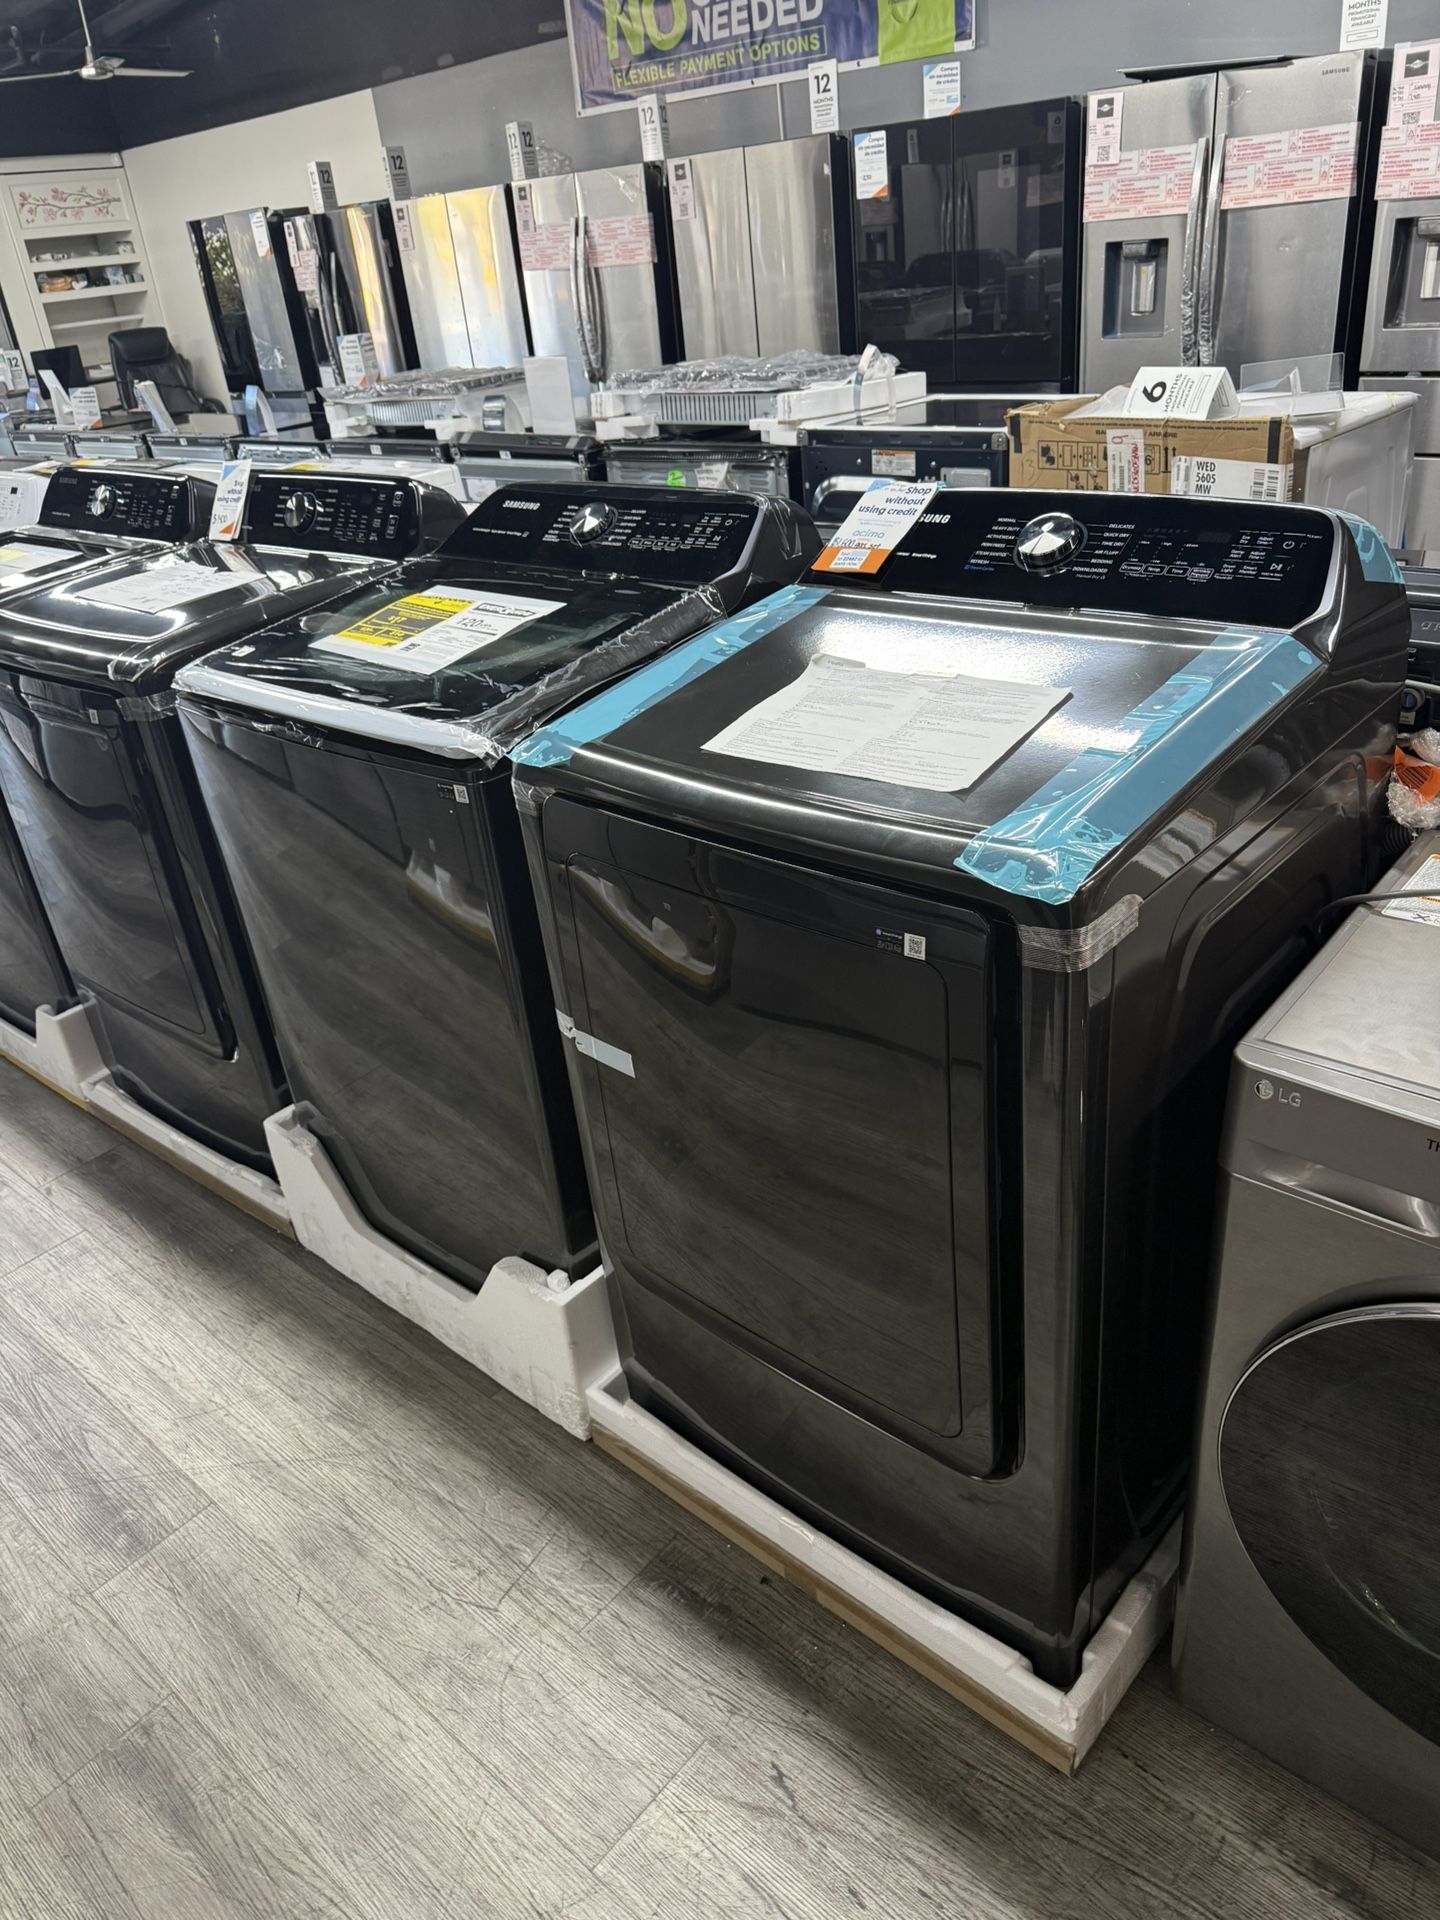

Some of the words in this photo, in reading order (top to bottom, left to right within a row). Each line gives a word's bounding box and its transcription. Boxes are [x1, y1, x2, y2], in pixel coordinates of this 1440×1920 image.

[1348, 0, 1382, 11] MONTHS
[604, 0, 688, 60] NO
[691, 0, 824, 46] NEEDED
[615, 62, 675, 89] FLEXIBLE
[679, 47, 746, 75] PAYMENT
[749, 32, 821, 62] OPTIONS
[814, 73, 831, 94] 12
[641, 105, 655, 125] 12
[521, 131, 533, 148] 12
[391, 154, 404, 171] 12
[320, 169, 332, 184] 12
[7, 356, 20, 369] 12
[1142, 381, 1167, 403] 6
[1164, 373, 1183, 413] MONTHS
[1196, 461, 1216, 472] WED
[1195, 472, 1216, 484] 5605
[905, 486, 932, 496] Shop
[1194, 484, 1212, 495] MW
[502, 500, 541, 511] SAMSUNG
[885, 496, 926, 506] without
[858, 504, 886, 516] using
[886, 506, 918, 516] credit
[852, 529, 885, 539] acima
[1278, 1088, 1301, 1107] LG
